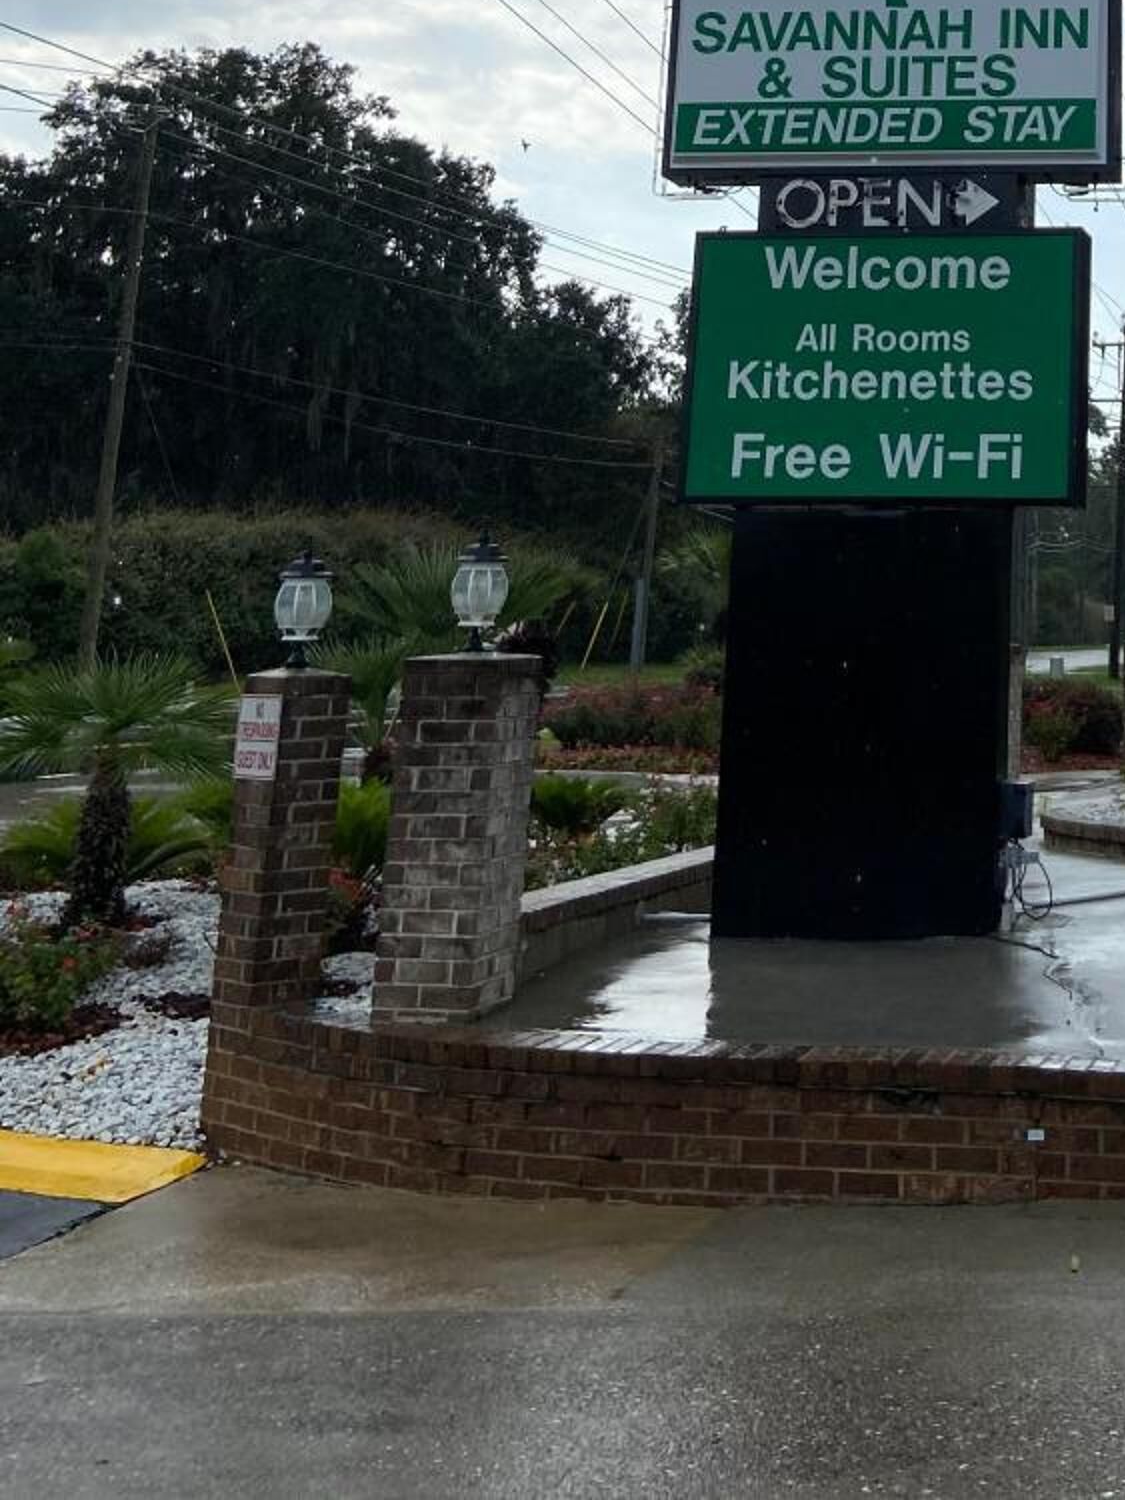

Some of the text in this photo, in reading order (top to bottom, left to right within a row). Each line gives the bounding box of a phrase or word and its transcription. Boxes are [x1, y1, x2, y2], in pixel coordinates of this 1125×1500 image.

[692, 8, 1089, 54] SAVANNAH INN
[757, 54, 1017, 99] & SUITES
[692, 106, 1077, 145] EXTENDED STAY
[776, 177, 942, 228] OPEN
[764, 245, 1011, 290] Welcome
[795, 324, 971, 352] All Rooms
[727, 360, 1033, 400] Kitchenettes
[731, 433, 1023, 479] Free Wi-Fi
